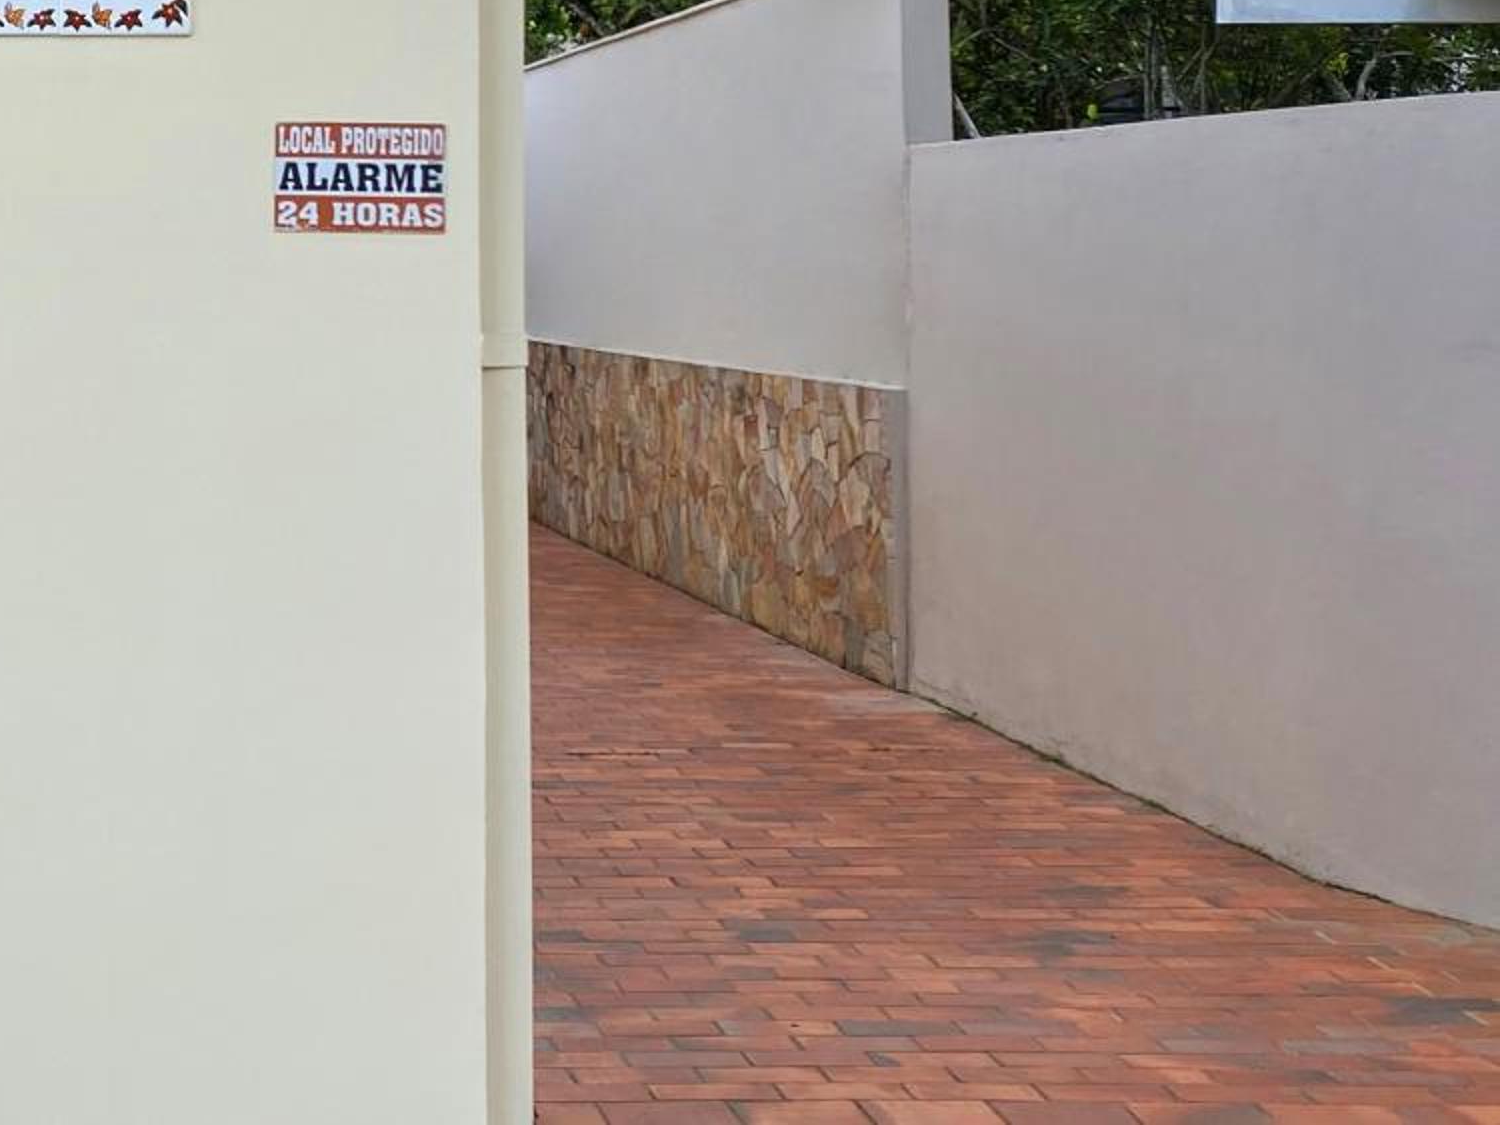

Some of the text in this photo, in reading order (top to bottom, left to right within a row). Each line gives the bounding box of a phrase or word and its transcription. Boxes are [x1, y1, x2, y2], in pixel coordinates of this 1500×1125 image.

[278, 126, 444, 156] LOCAL PROTEGIDO
[278, 161, 444, 193] ALARME
[277, 201, 444, 227] 24 HORAS
